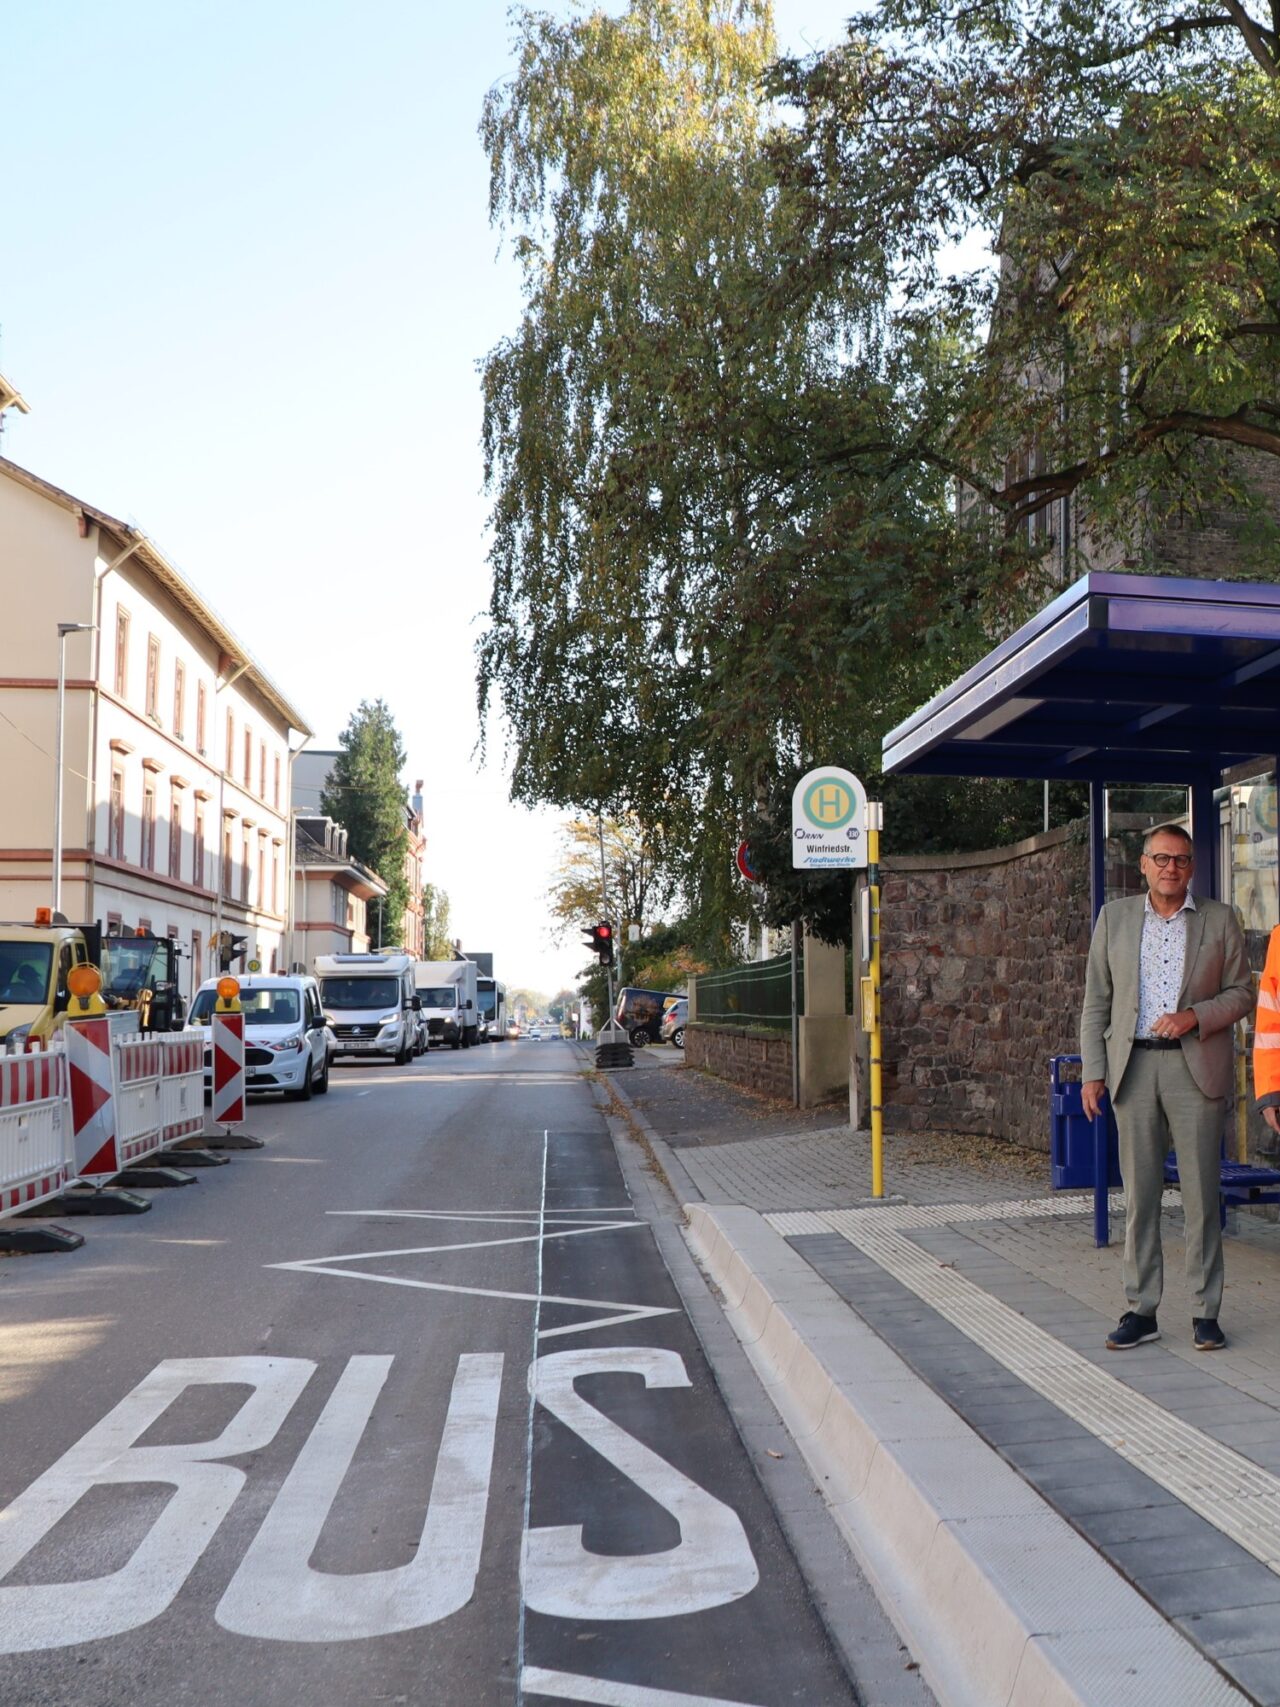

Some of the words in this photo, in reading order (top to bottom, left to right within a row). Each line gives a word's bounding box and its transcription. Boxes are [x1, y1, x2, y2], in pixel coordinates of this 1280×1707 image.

[819, 789, 840, 818] H
[806, 845, 853, 853] Winfriedstr.
[0, 1346, 759, 1656] BUS
